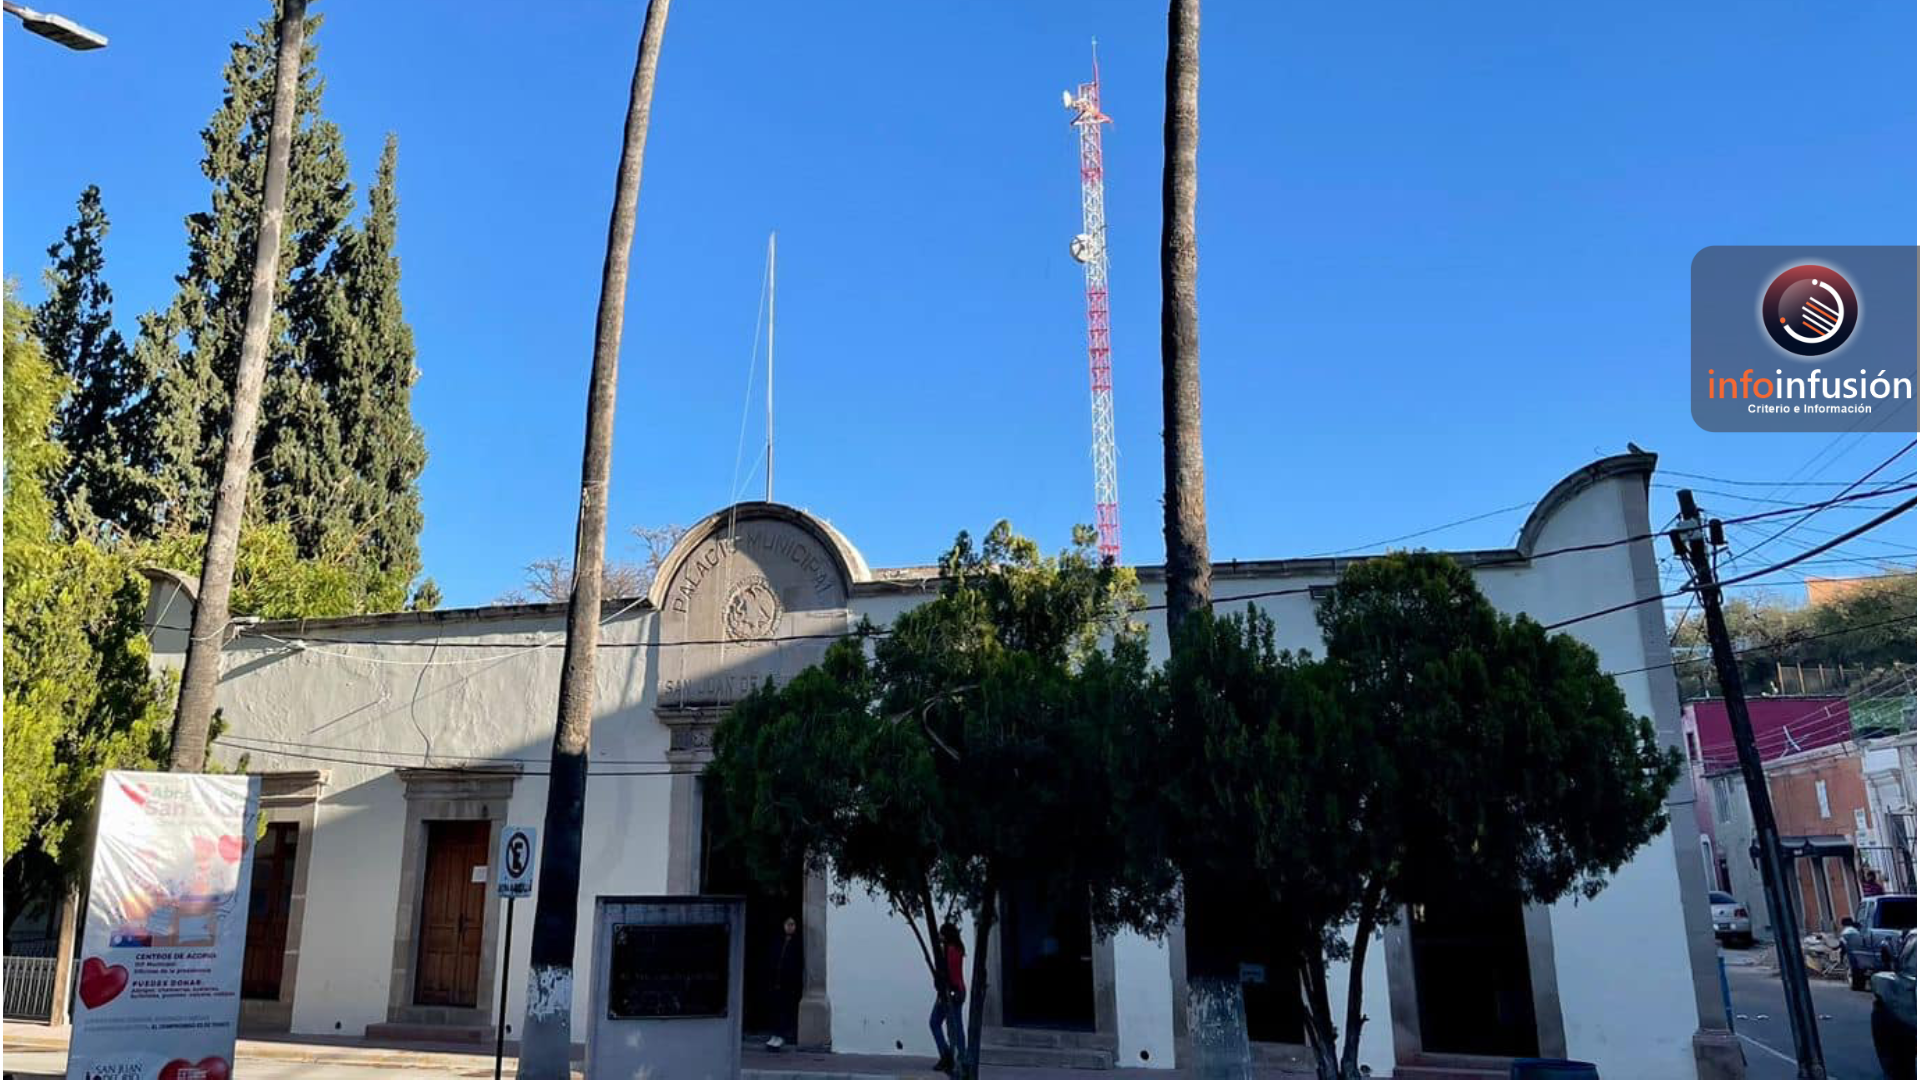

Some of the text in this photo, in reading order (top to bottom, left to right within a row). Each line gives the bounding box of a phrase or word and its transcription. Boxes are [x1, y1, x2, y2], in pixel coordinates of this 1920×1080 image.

[672, 532, 836, 614] PALACIO MUNICIPAL
[665, 679, 692, 696] SAN
[698, 675, 734, 696] JUAN
